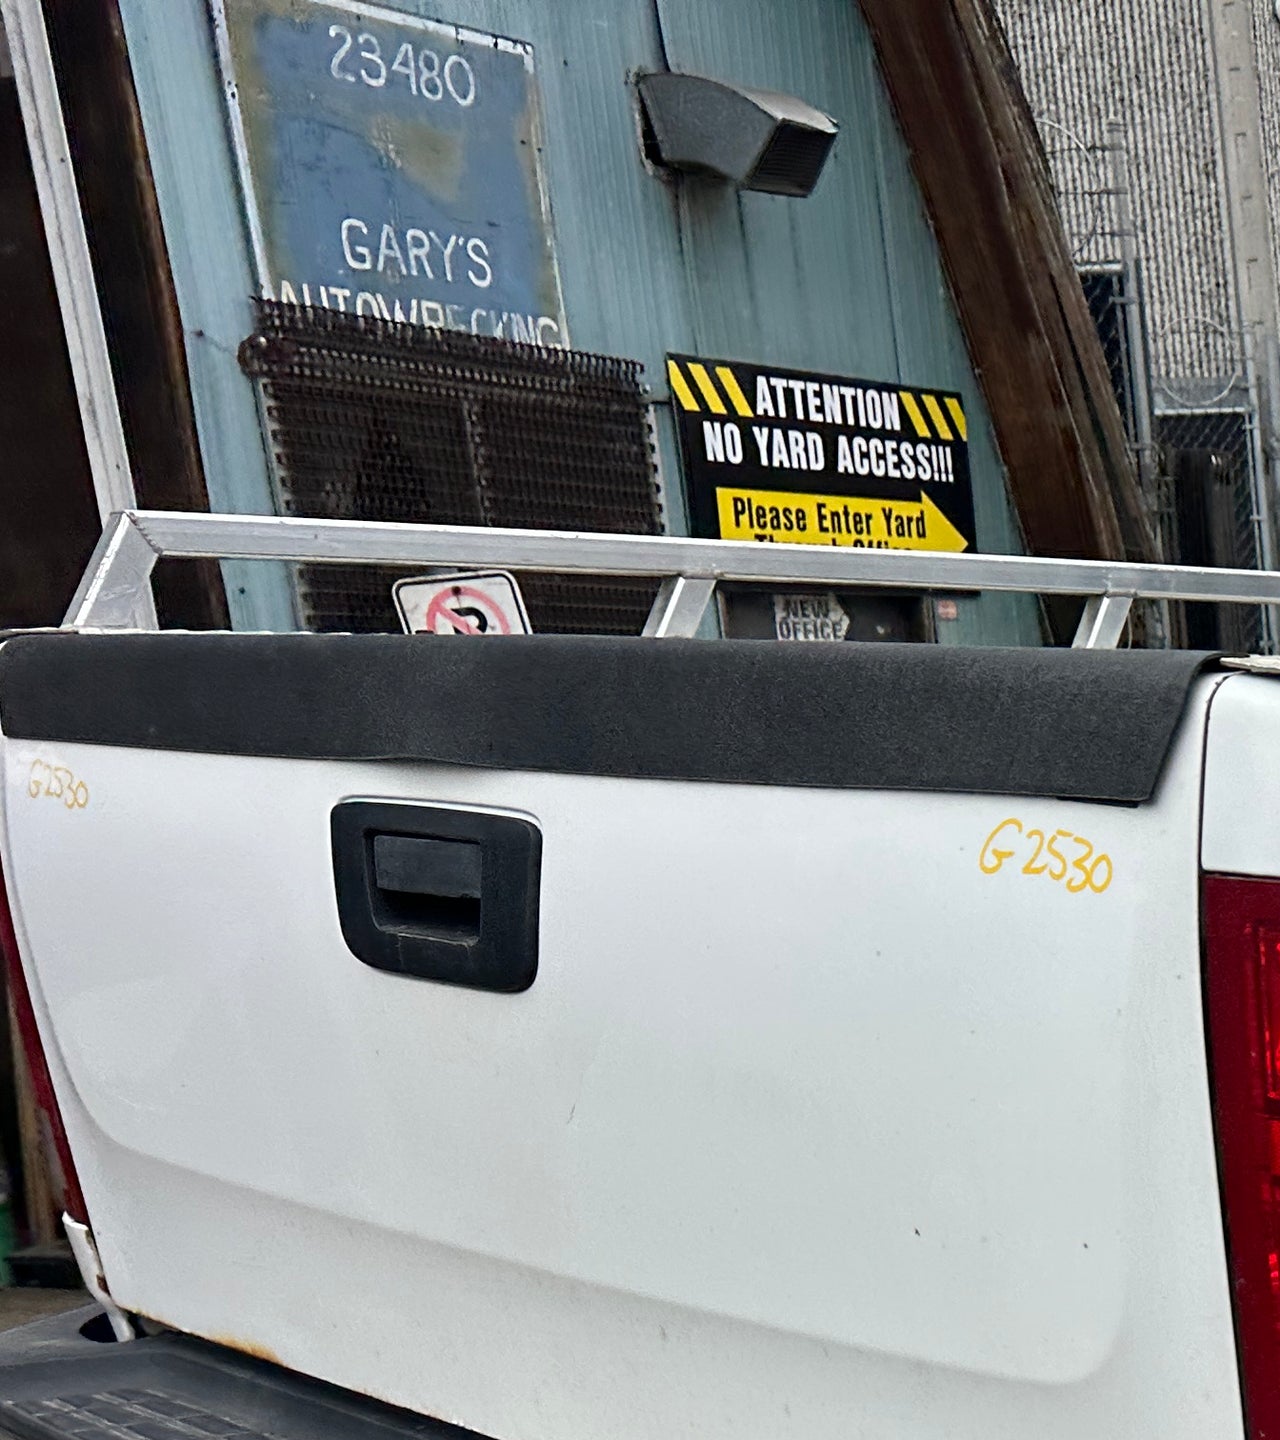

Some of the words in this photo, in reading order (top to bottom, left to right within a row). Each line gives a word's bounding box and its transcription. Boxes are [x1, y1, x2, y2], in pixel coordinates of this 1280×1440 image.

[329, 24, 475, 107] 23480
[341, 218, 492, 288] GARY'S
[756, 375, 900, 431] ATTENTION
[703, 421, 743, 464] NO
[752, 426, 825, 471] YARD
[837, 435, 954, 483] ACCESS!!!
[732, 497, 807, 532] Please
[817, 503, 872, 536] Enter
[882, 508, 926, 538] Yard
[779, 616, 845, 641] OFFICE
[980, 818, 1113, 893] G2530
